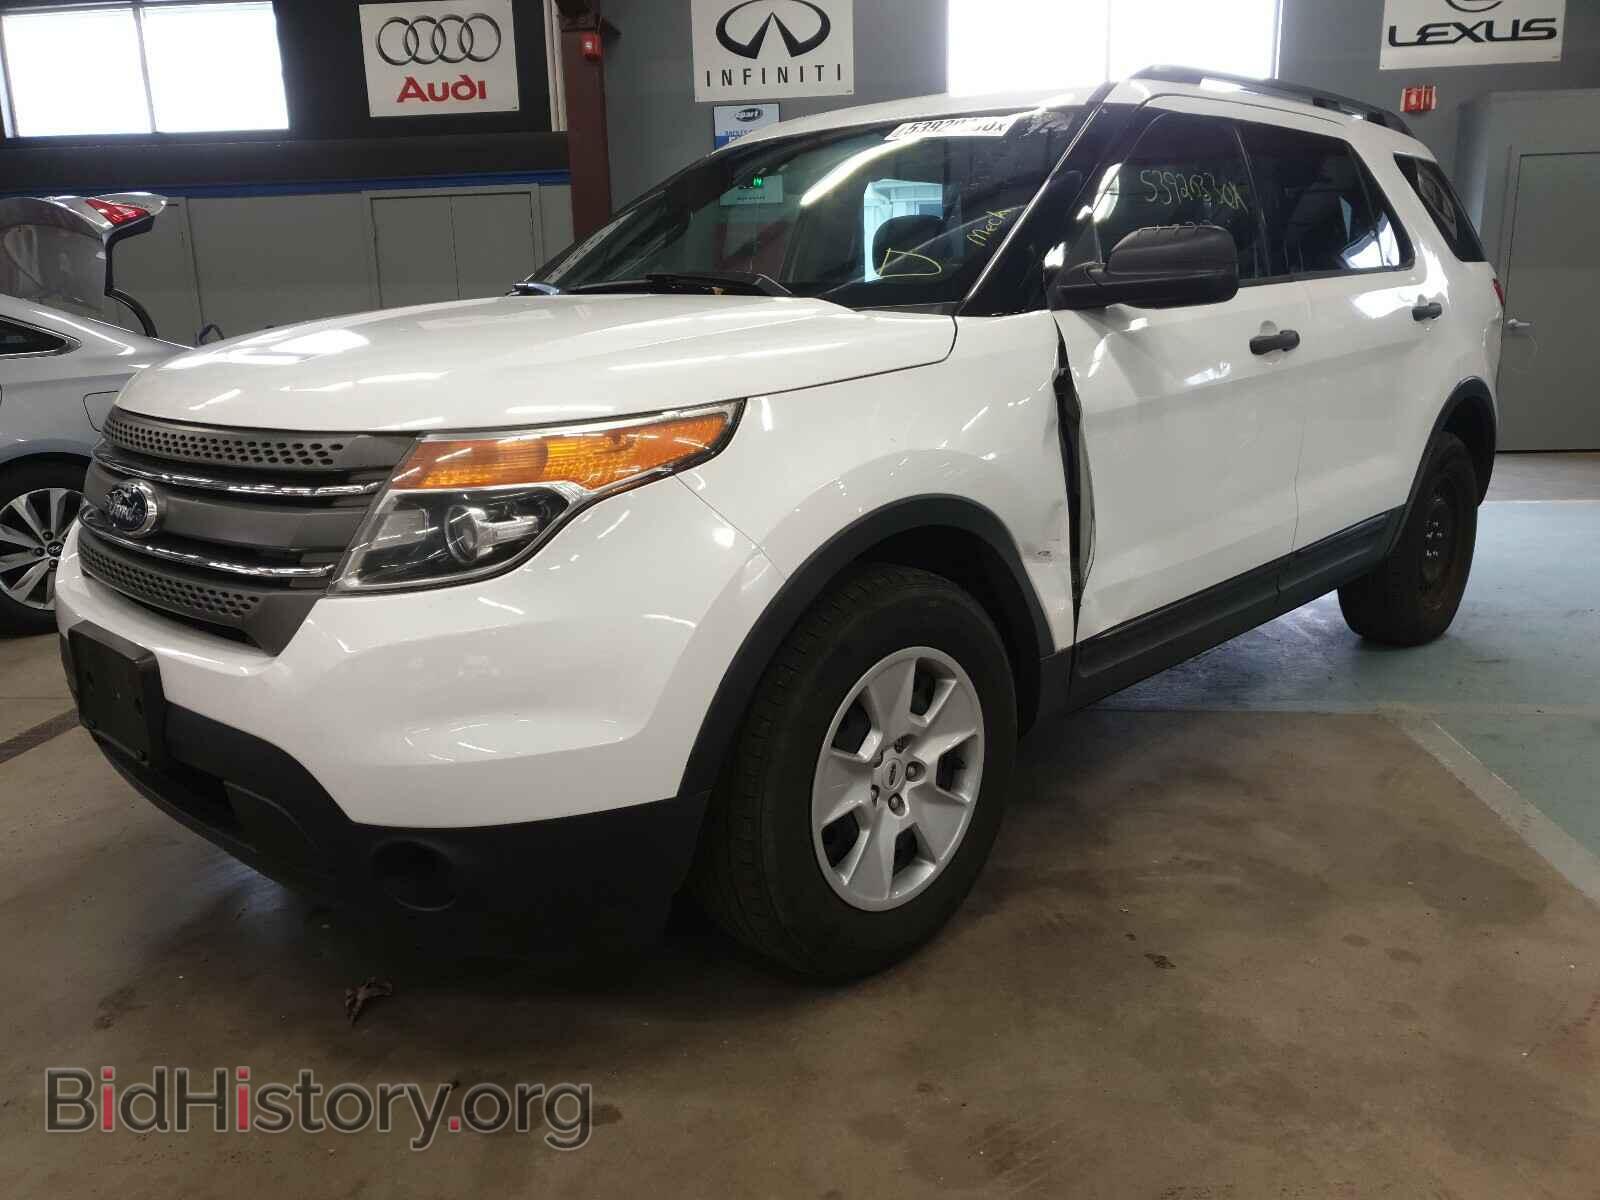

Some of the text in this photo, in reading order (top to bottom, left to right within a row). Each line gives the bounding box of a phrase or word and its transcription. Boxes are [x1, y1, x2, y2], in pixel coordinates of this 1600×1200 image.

[1388, 17, 1558, 47] LEXUS
[396, 75, 487, 103] Audi
[706, 63, 841, 87] INFINITI
